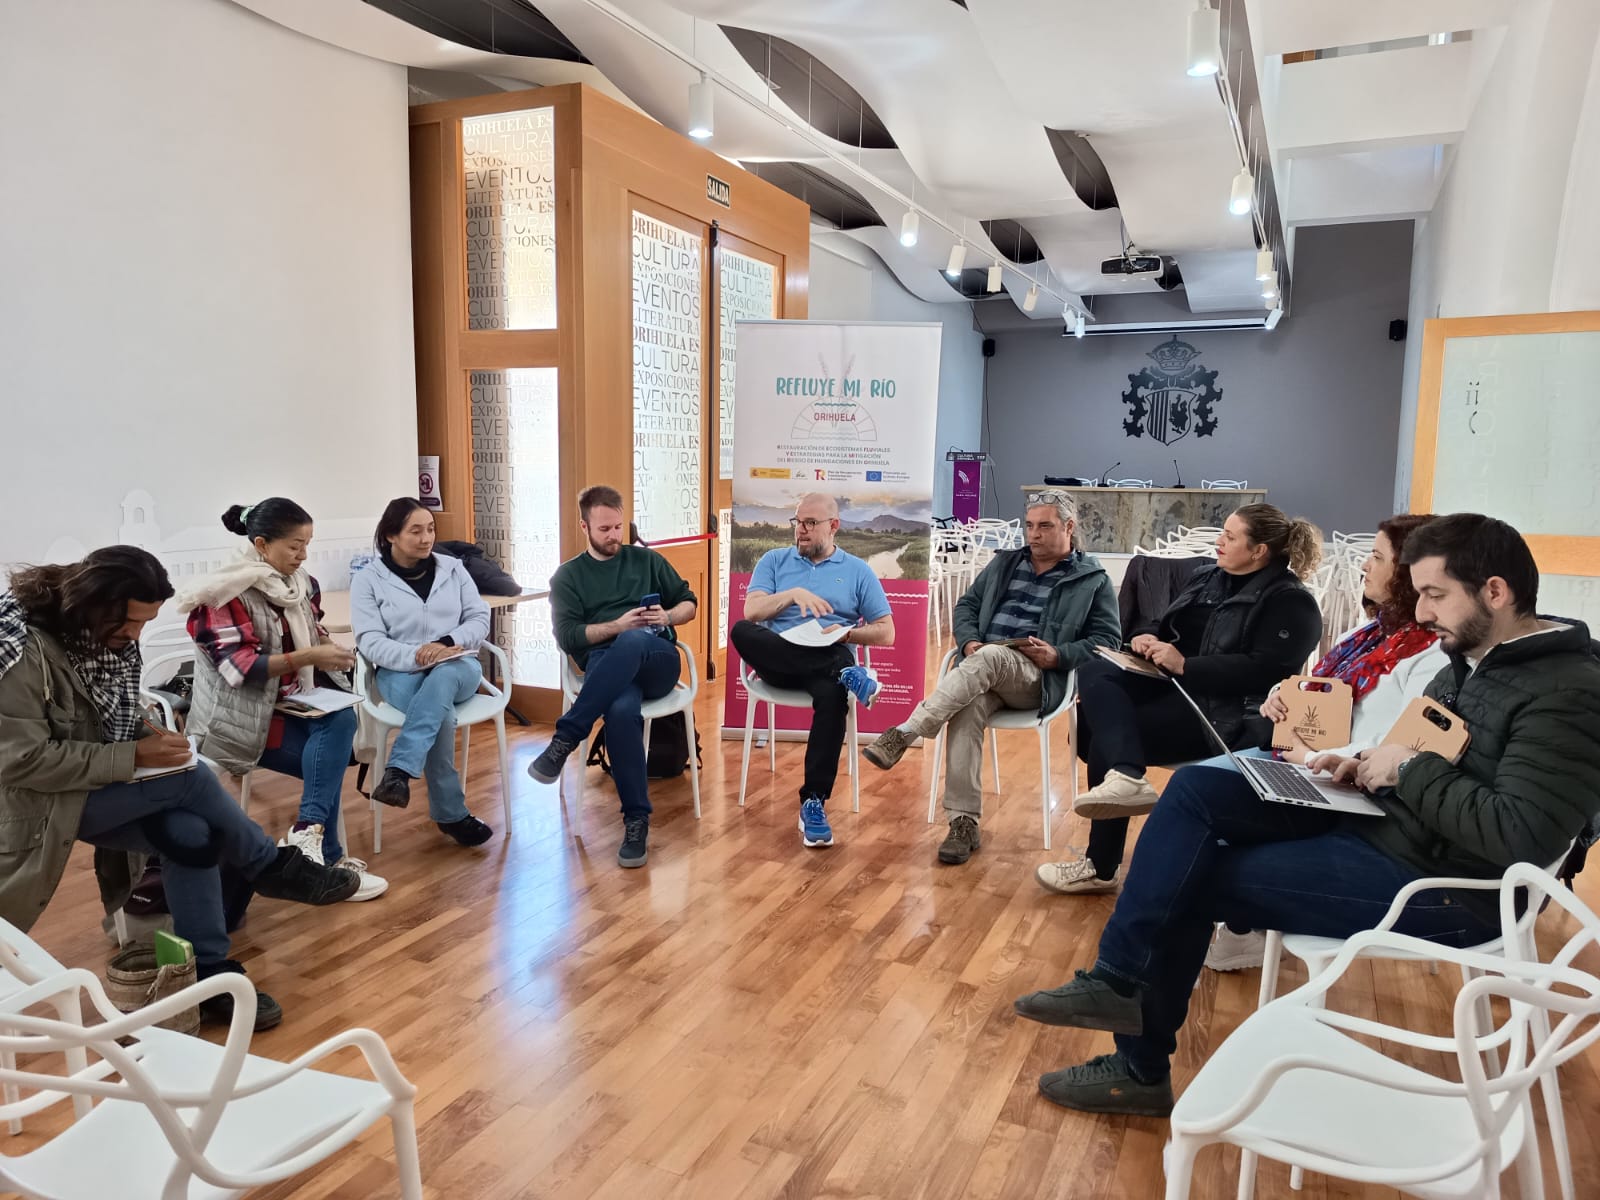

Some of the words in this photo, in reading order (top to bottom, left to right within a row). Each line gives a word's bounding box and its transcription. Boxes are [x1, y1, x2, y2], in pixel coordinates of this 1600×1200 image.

[464, 117, 533, 137] ORIHUELA
[464, 129, 552, 155] CULTURA
[465, 163, 552, 190] EVENTOS
[465, 184, 553, 204] LITERATURA
[707, 178, 730, 205] SALIDA
[539, 200, 554, 213] ES
[633, 214, 687, 249] ORIHUELA
[633, 235, 699, 275] CULTURA
[633, 261, 700, 293] EXPOSICIONES
[633, 278, 700, 319] EVENTOS
[633, 303, 700, 337] LITERATURA
[633, 325, 686, 351] ORIHUELA
[689, 337, 700, 353] ES
[633, 344, 699, 374] CULTURA
[633, 369, 699, 392] EXPOSICIONES
[776, 377, 835, 397] REFLUYE
[843, 378, 861, 398] MI
[870, 377, 896, 398] RÍO
[633, 386, 699, 415] EVENTOS
[814, 412, 856, 422] ORIHUELA
